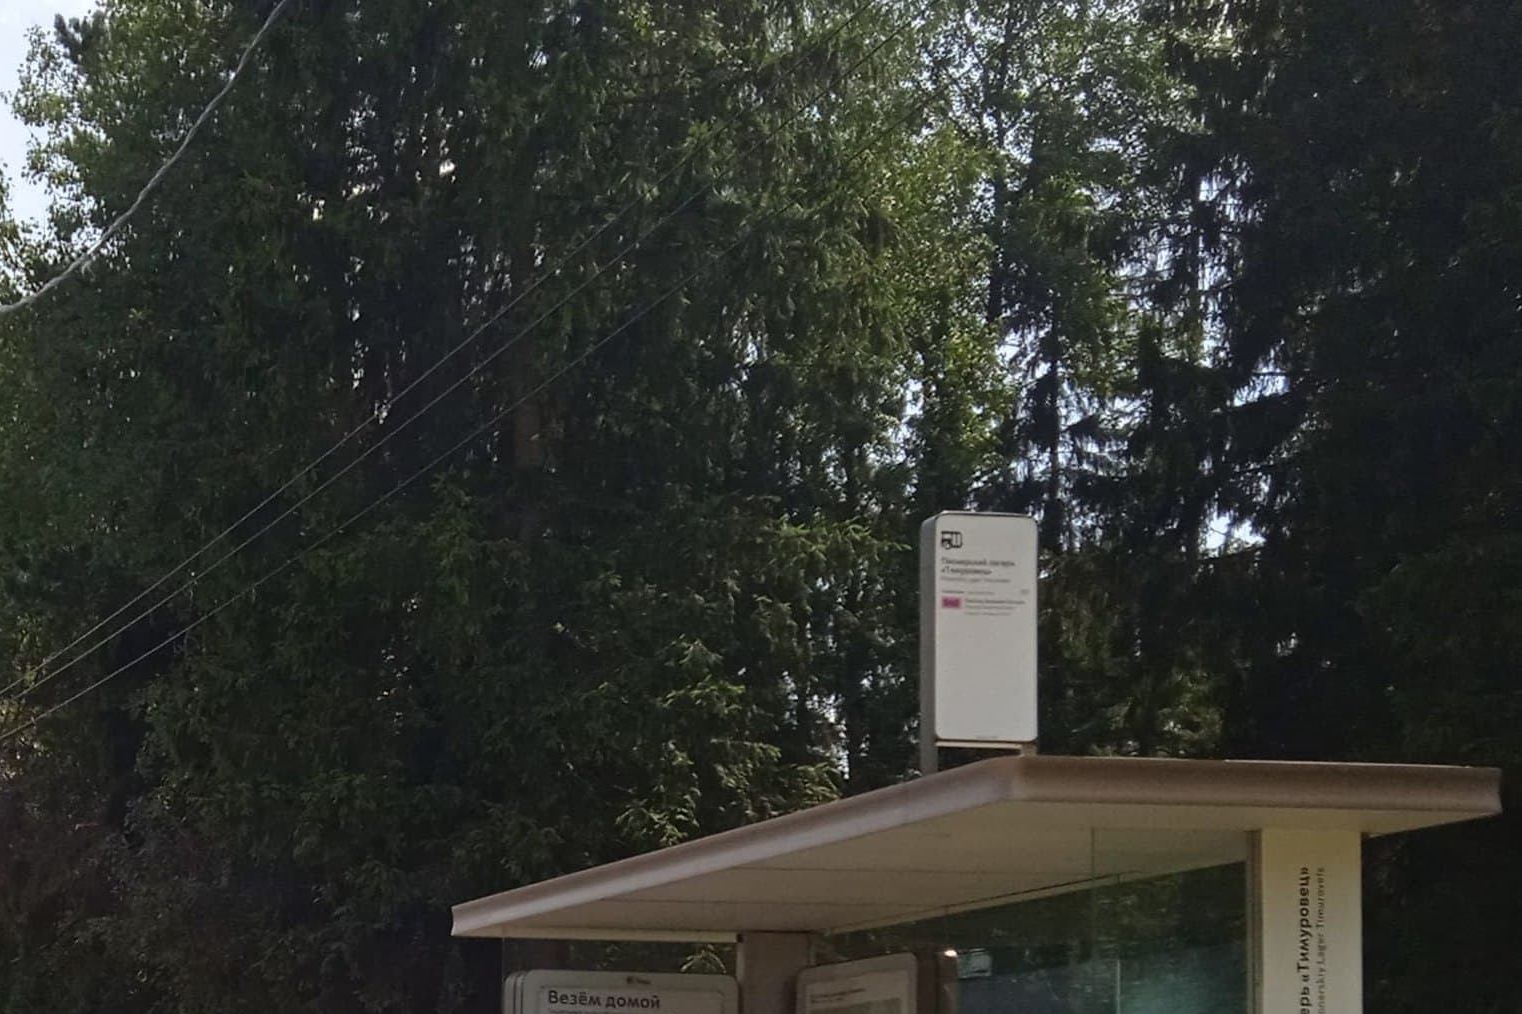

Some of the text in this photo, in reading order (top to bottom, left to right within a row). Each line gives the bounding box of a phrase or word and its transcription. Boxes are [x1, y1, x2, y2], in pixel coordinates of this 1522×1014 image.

[1297, 866, 1312, 983] «Тимуровец»
[1315, 933, 1327, 964] Lager
[548, 989, 661, 1010] Везём домой
